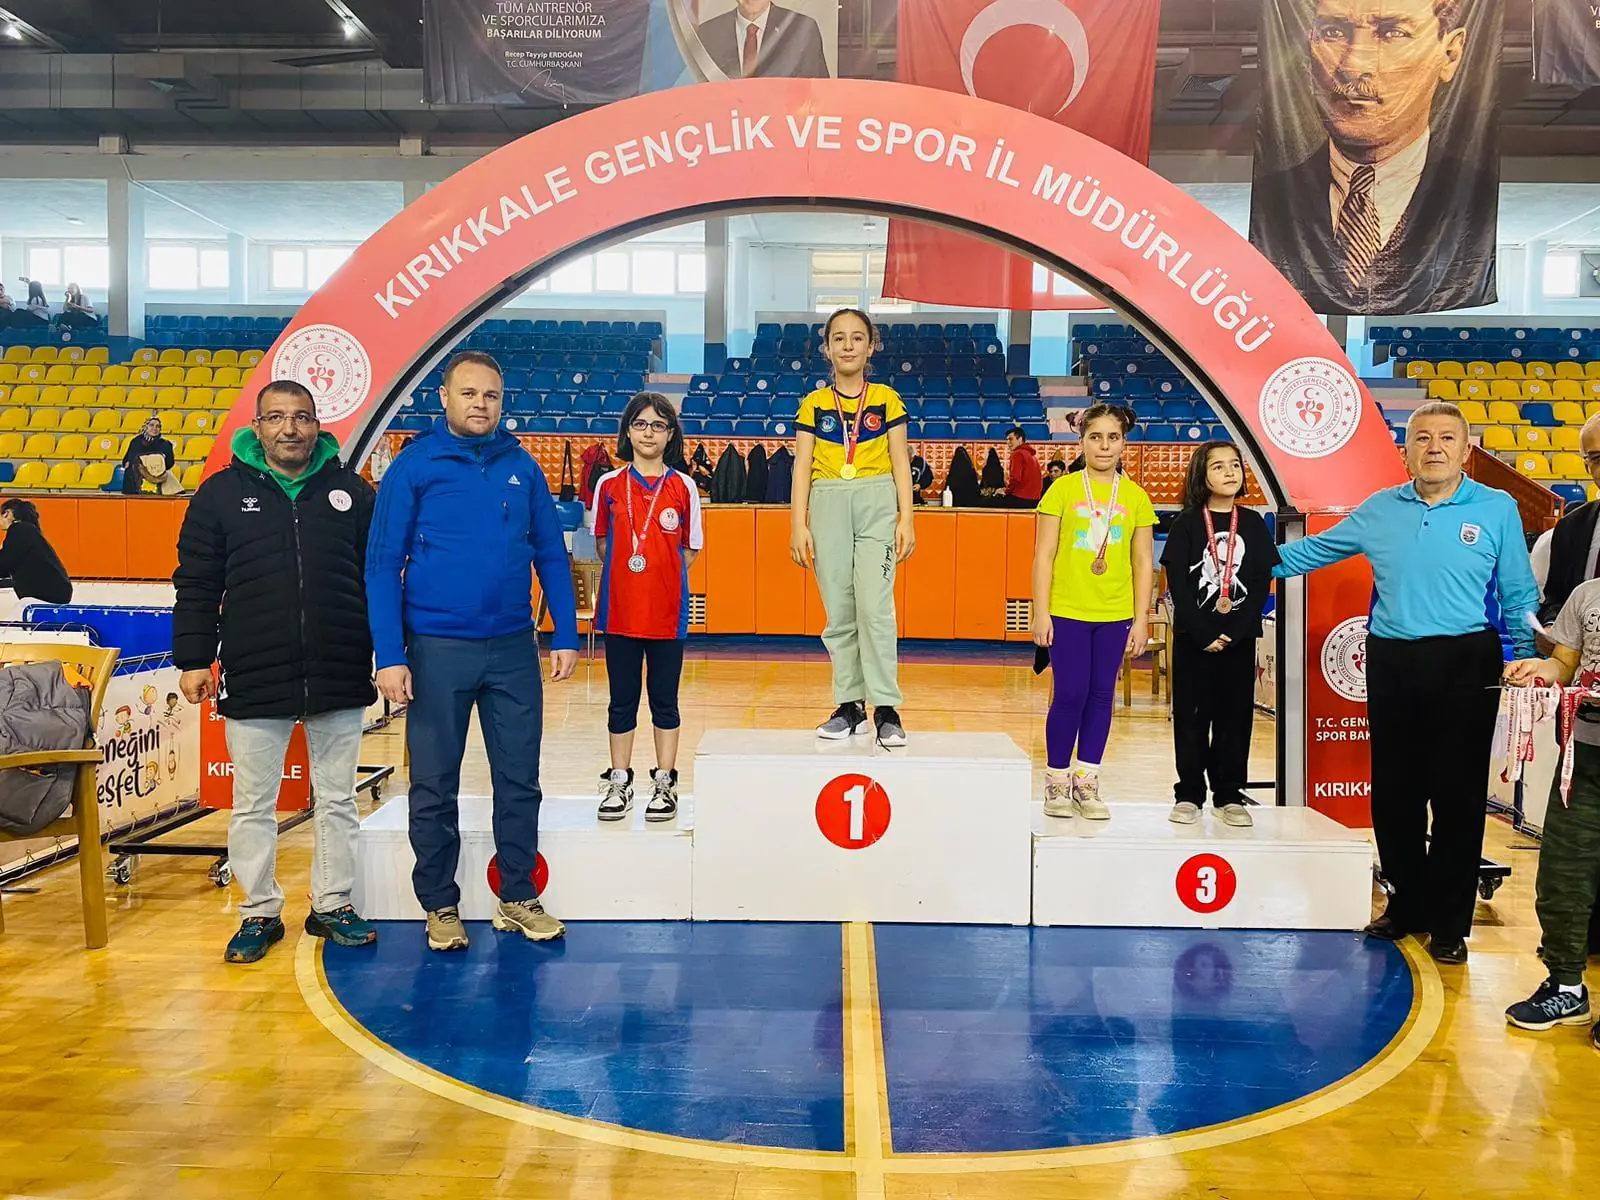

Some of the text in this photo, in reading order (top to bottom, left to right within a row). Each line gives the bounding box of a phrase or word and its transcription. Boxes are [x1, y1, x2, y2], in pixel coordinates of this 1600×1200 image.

[496, 0, 592, 13] TÜM ANTRENÖR
[482, 14, 606, 26] VE SPORCULARIMIZA
[487, 28, 601, 39] BAŞARILAR DİLİYORUM
[549, 50, 583, 58] ERDOĞAN
[374, 110, 1275, 351] KIRIKKALE GENÇLİK VE SPOR İL MÜDÜRLÜĞÜ
[1316, 718, 1337, 728] T.C.
[1316, 731, 1346, 741] SPOR
[96, 761, 145, 807] eşfet
[1315, 782, 1371, 797] KIRIKK
[843, 785, 864, 840] 1
[1196, 866, 1217, 903] 3
